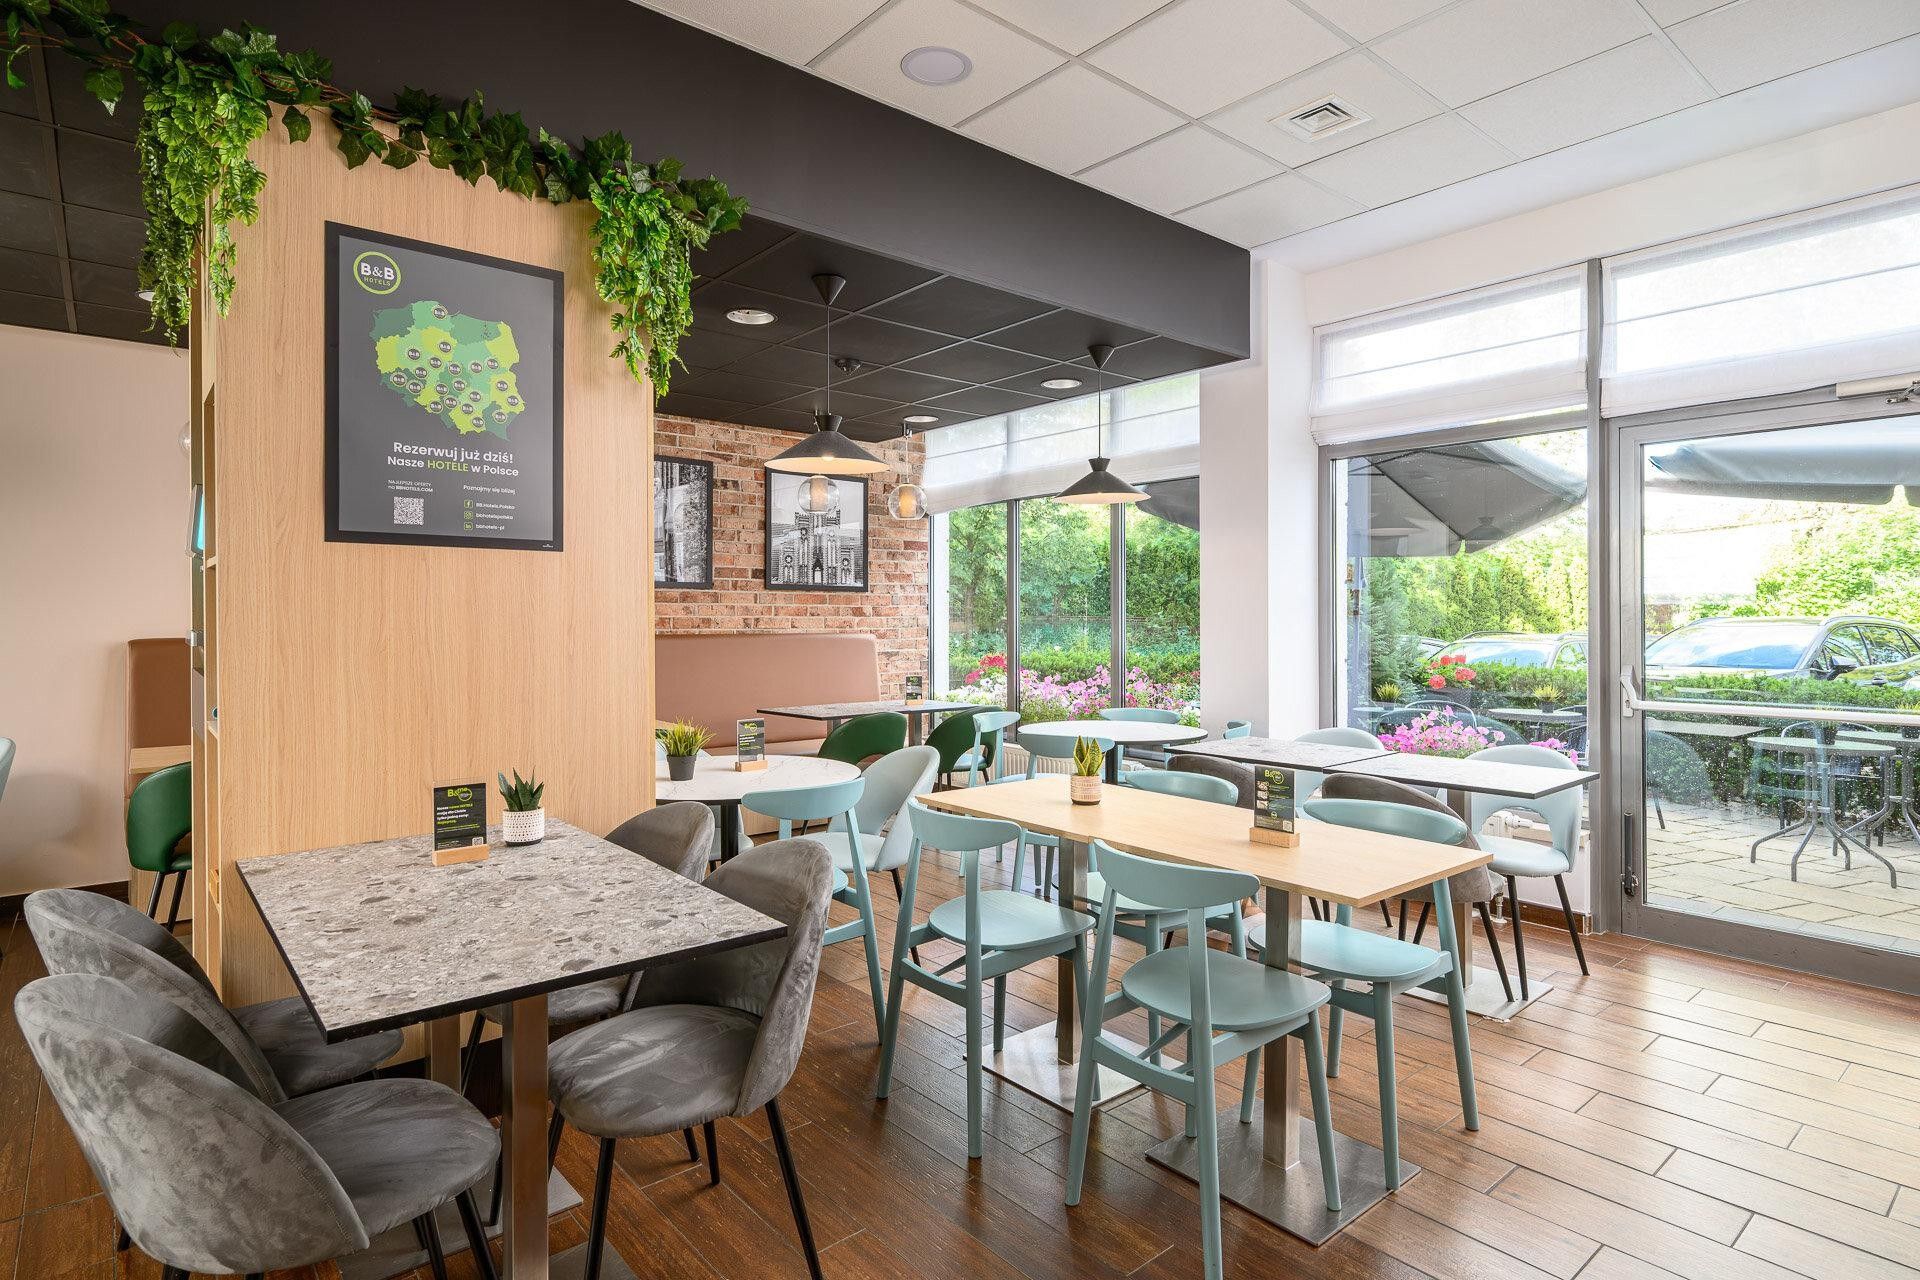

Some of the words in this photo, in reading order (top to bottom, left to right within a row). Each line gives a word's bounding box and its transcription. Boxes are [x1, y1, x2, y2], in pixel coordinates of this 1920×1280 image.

[360, 262, 395, 280] B&B
[363, 276, 391, 286] HOTELS
[393, 442, 458, 461] Rezerwuj
[460, 447, 480, 462] już
[483, 451, 513, 463] dziś!
[387, 456, 424, 468] Nasze
[427, 460, 468, 472] HOTELE
[471, 464, 480, 472] w
[483, 465, 519, 476] Polsce
